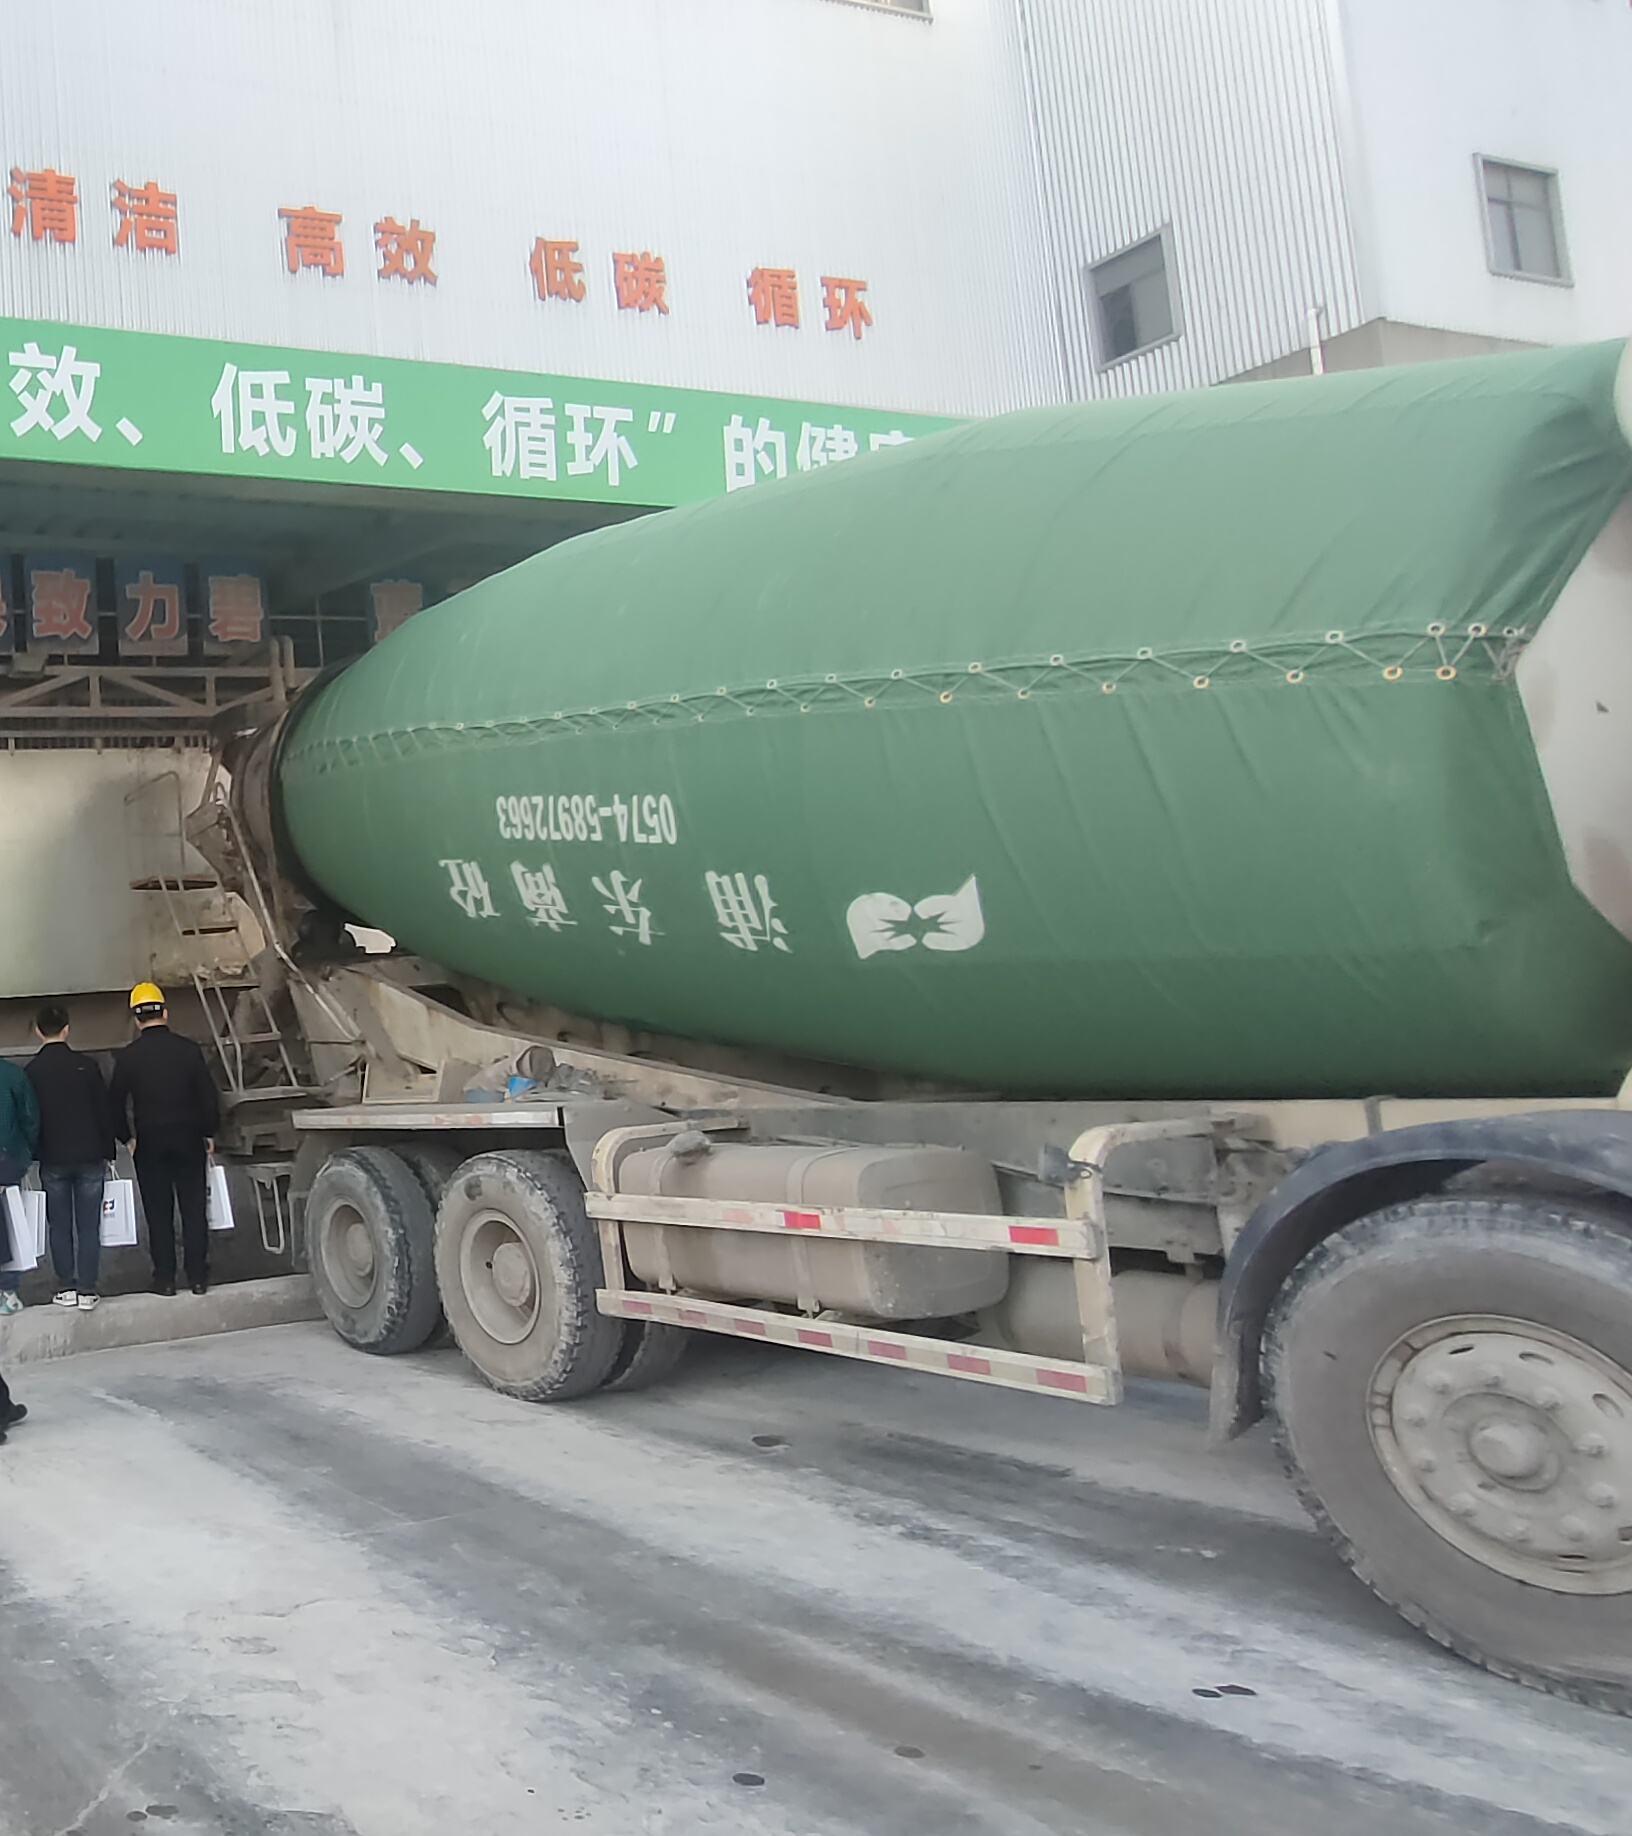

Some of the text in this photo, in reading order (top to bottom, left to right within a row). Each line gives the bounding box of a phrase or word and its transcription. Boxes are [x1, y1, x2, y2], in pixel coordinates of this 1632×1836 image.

[8, 167, 872, 340] 清洁 高效 低碳 循环
[495, 793, 677, 845] 0574-58972663
